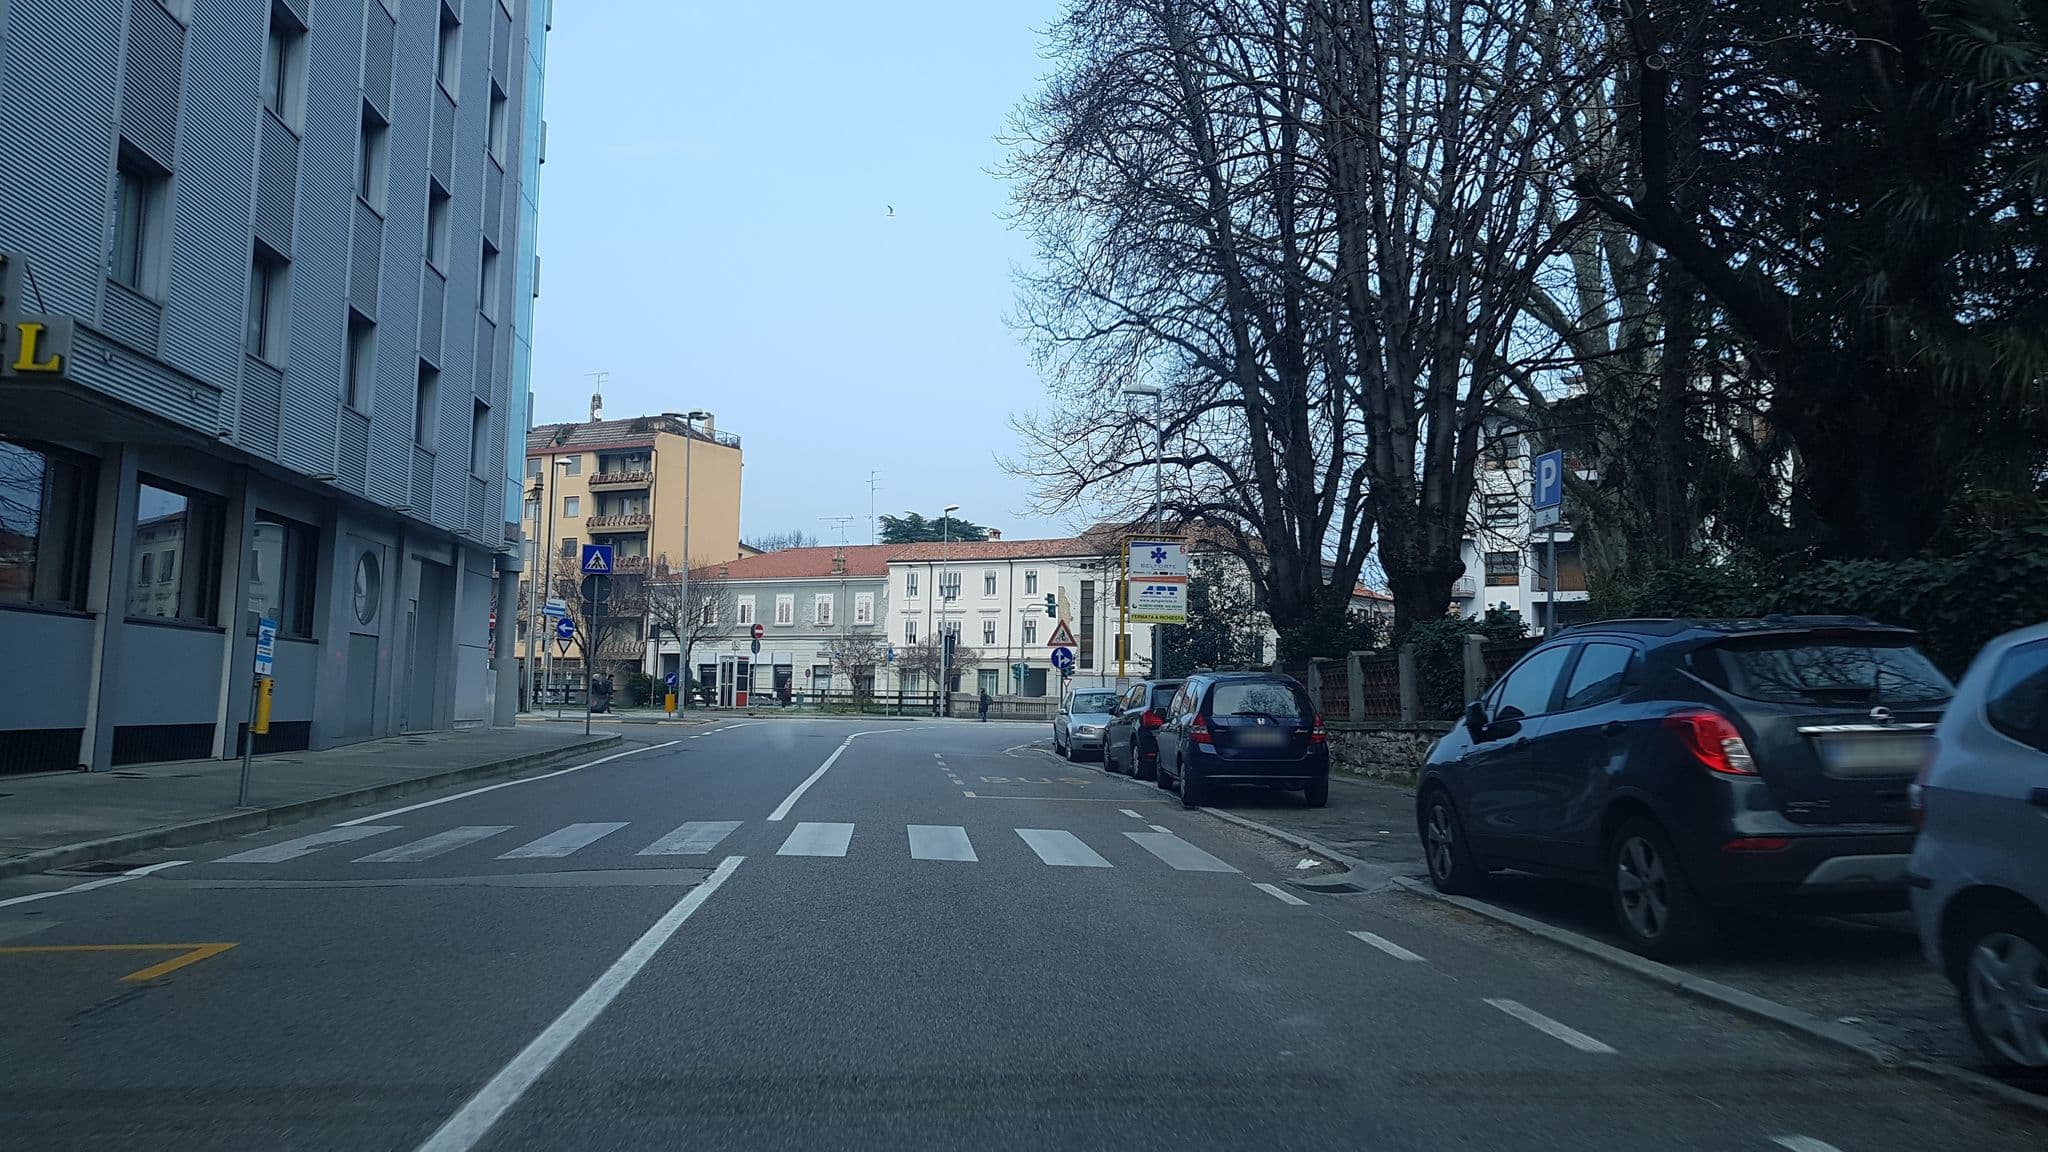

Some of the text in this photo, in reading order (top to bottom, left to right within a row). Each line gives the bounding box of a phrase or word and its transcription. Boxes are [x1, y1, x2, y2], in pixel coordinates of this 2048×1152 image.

[1540, 458, 1556, 503] P
[1140, 585, 1178, 595] APT
[979, 776, 1092, 785] BUS
